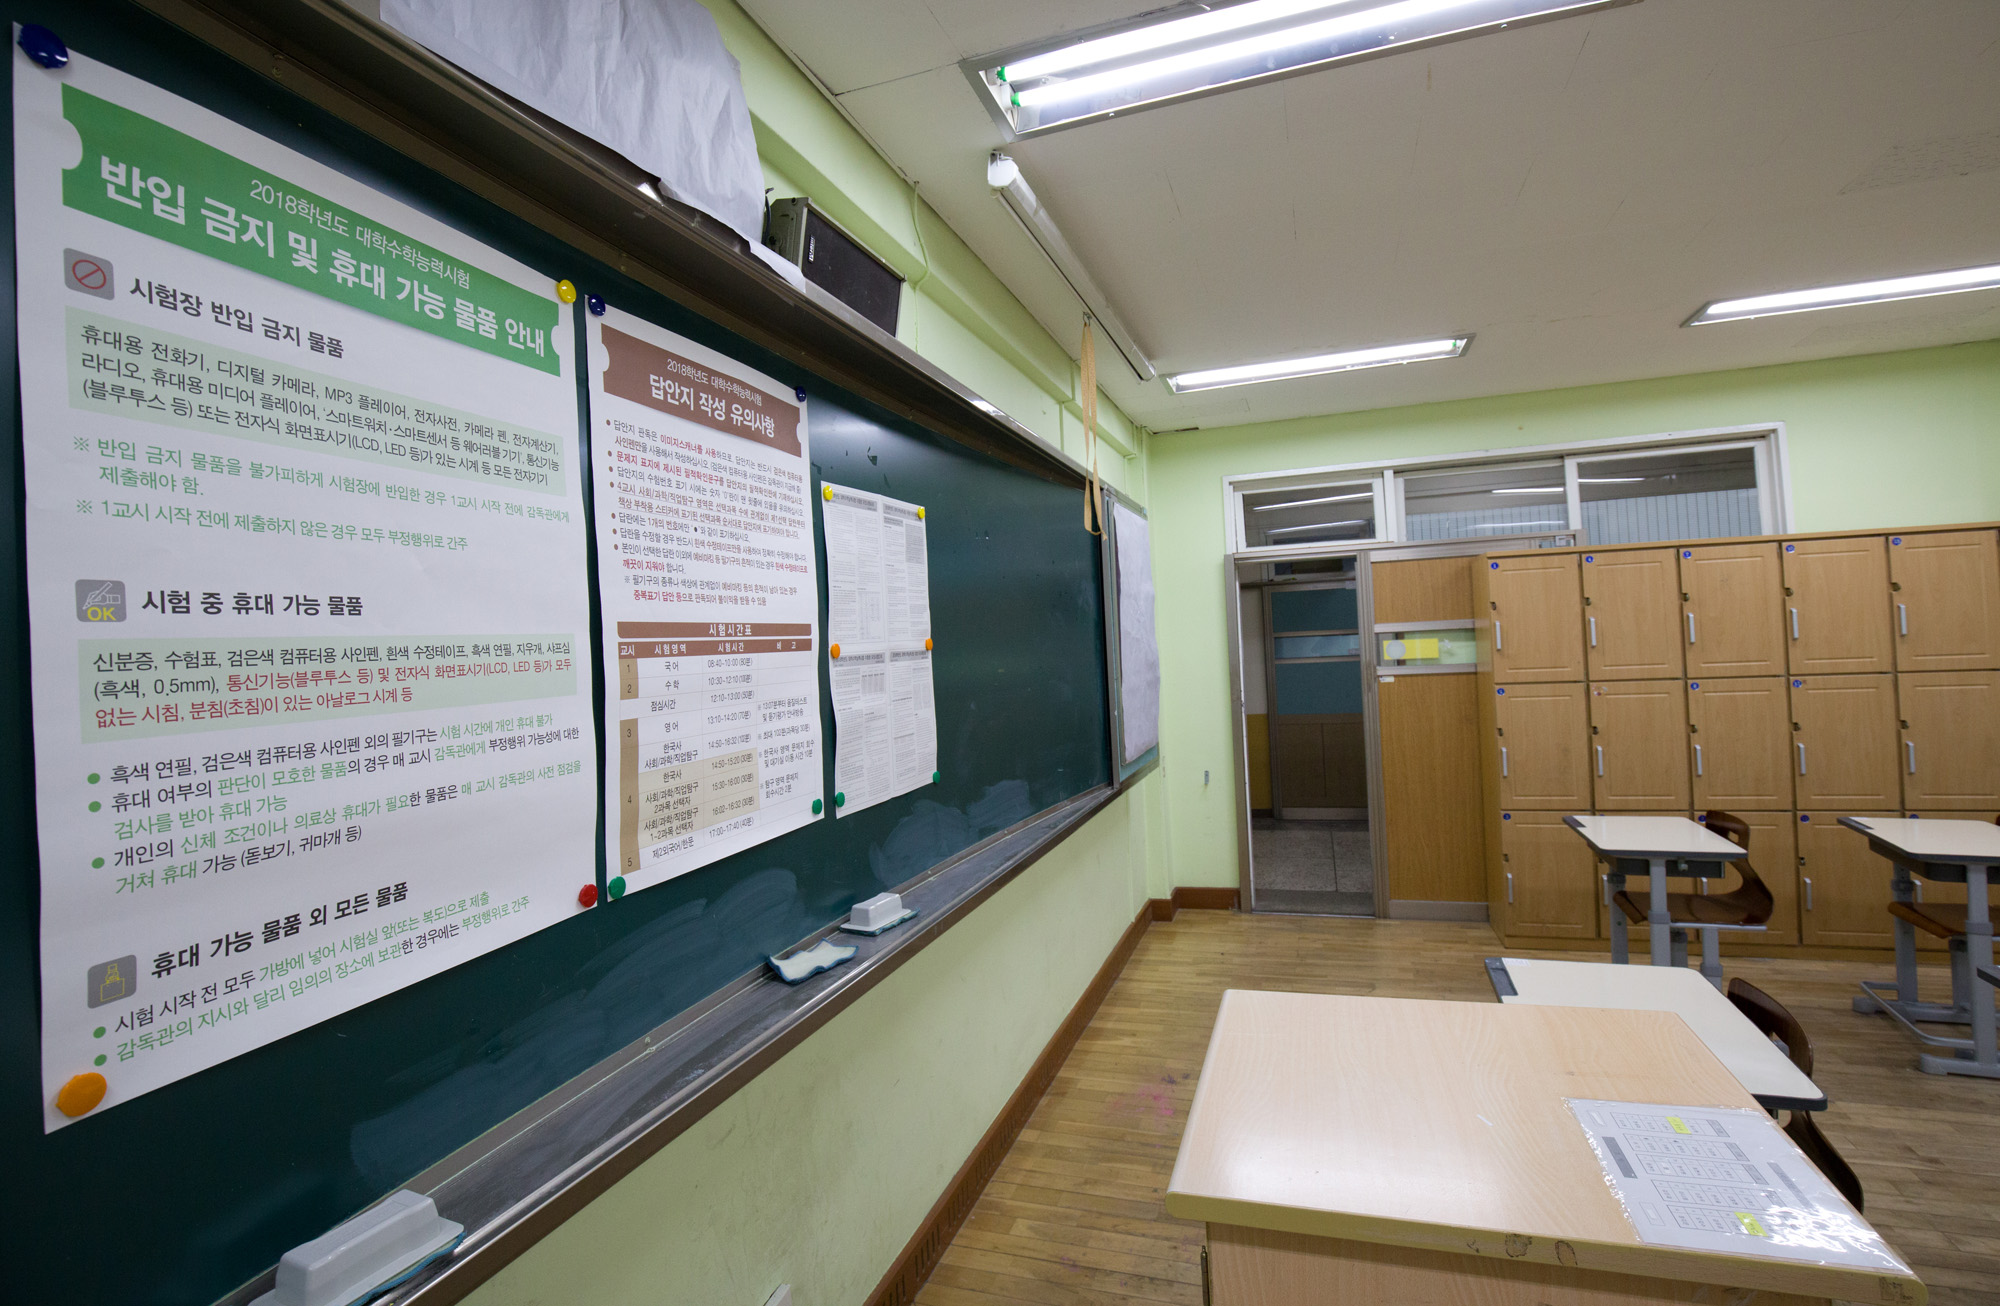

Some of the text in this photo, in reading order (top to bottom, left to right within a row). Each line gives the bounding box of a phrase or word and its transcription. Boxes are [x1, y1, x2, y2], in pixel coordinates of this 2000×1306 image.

[249, 179, 469, 290] 2018학년도 대학수학능력시험
[101, 155, 544, 356] 반입 금지 및 휴대 가능 물품 안내
[129, 277, 344, 359] 시험장 반입 금지 물품
[80, 325, 558, 455] 휴대용 전화기, 디지털 카메라, MP3 플레이어, 전자사전, 카메라 펜, 전자계산기,
[667, 358, 762, 406] 2018학년도 대학수학능력시험
[649, 373, 775, 438] 답안지 작성 유의사항
[97, 438, 569, 523] 반입 금지 물품을 불가피하게 시험장에 반입한 경우 1교시 시작 전에 감독관에게
[99, 465, 203, 496] 제출해야 함.
[101, 499, 468, 551] 1교시 시작 전에 제출하지 않은 경우 모두 부정행위로 간주
[619, 512, 646, 526] 답란에는
[648, 517, 664, 529] 1개의
[666, 521, 689, 533] 번호에만
[707, 527, 718, 538] 같이
[623, 559, 643, 570] 깨끗이
[645, 561, 665, 572] 지워야
[87, 606, 116, 621] OK
[141, 590, 363, 616] 시험 중 휴대 가능 물품
[709, 623, 752, 636] 시험시간표
[92, 641, 570, 672] 신분증, 수험표, 검은색 컴퓨터용 사인펜, 흰색 수정테이프, 흑색 연필, 지우개, 샤프심
[620, 644, 635, 656] 교시
[654, 643, 687, 655] 시험영역
[718, 642, 744, 652] 시험시간
[627, 664, 631, 673] 1
[665, 661, 679, 672] 국어
[93, 658, 572, 702] (흑색, 0.5mm), 통신기능(블루투스 등) 및 전자식 화면표시기(LCD, LED 등)가 모두
[627, 683, 632, 694] 2
[665, 680, 680, 691] 수학
[95, 686, 413, 729] 없는 시침, 분침(초침)이 있는 아날로그 시계 등
[650, 699, 676, 712] 점심시간
[627, 729, 632, 738] 3
[665, 722, 679, 733] 영어
[663, 741, 682, 754] 한국사
[644, 750, 698, 770] 사회/과학/직업탐구
[663, 769, 682, 783] 한국사
[627, 795, 632, 804] 4
[645, 782, 699, 804] 사회/과학/직업탐구
[654, 796, 691, 814] 2과목 선택자
[114, 794, 288, 841] 검사를 받아 휴대 가능
[643, 807, 699, 831] 사회/과학/직업탐구
[675, 820, 694, 835] 선택자
[652, 836, 694, 859] 제2외국어/한문
[116, 824, 362, 894] 거쳐 휴대 가능 (돋보기, 귀마개 등)
[627, 857, 632, 867] 5
[151, 881, 408, 979] 휴대 가능 물품 외 모든 물품
